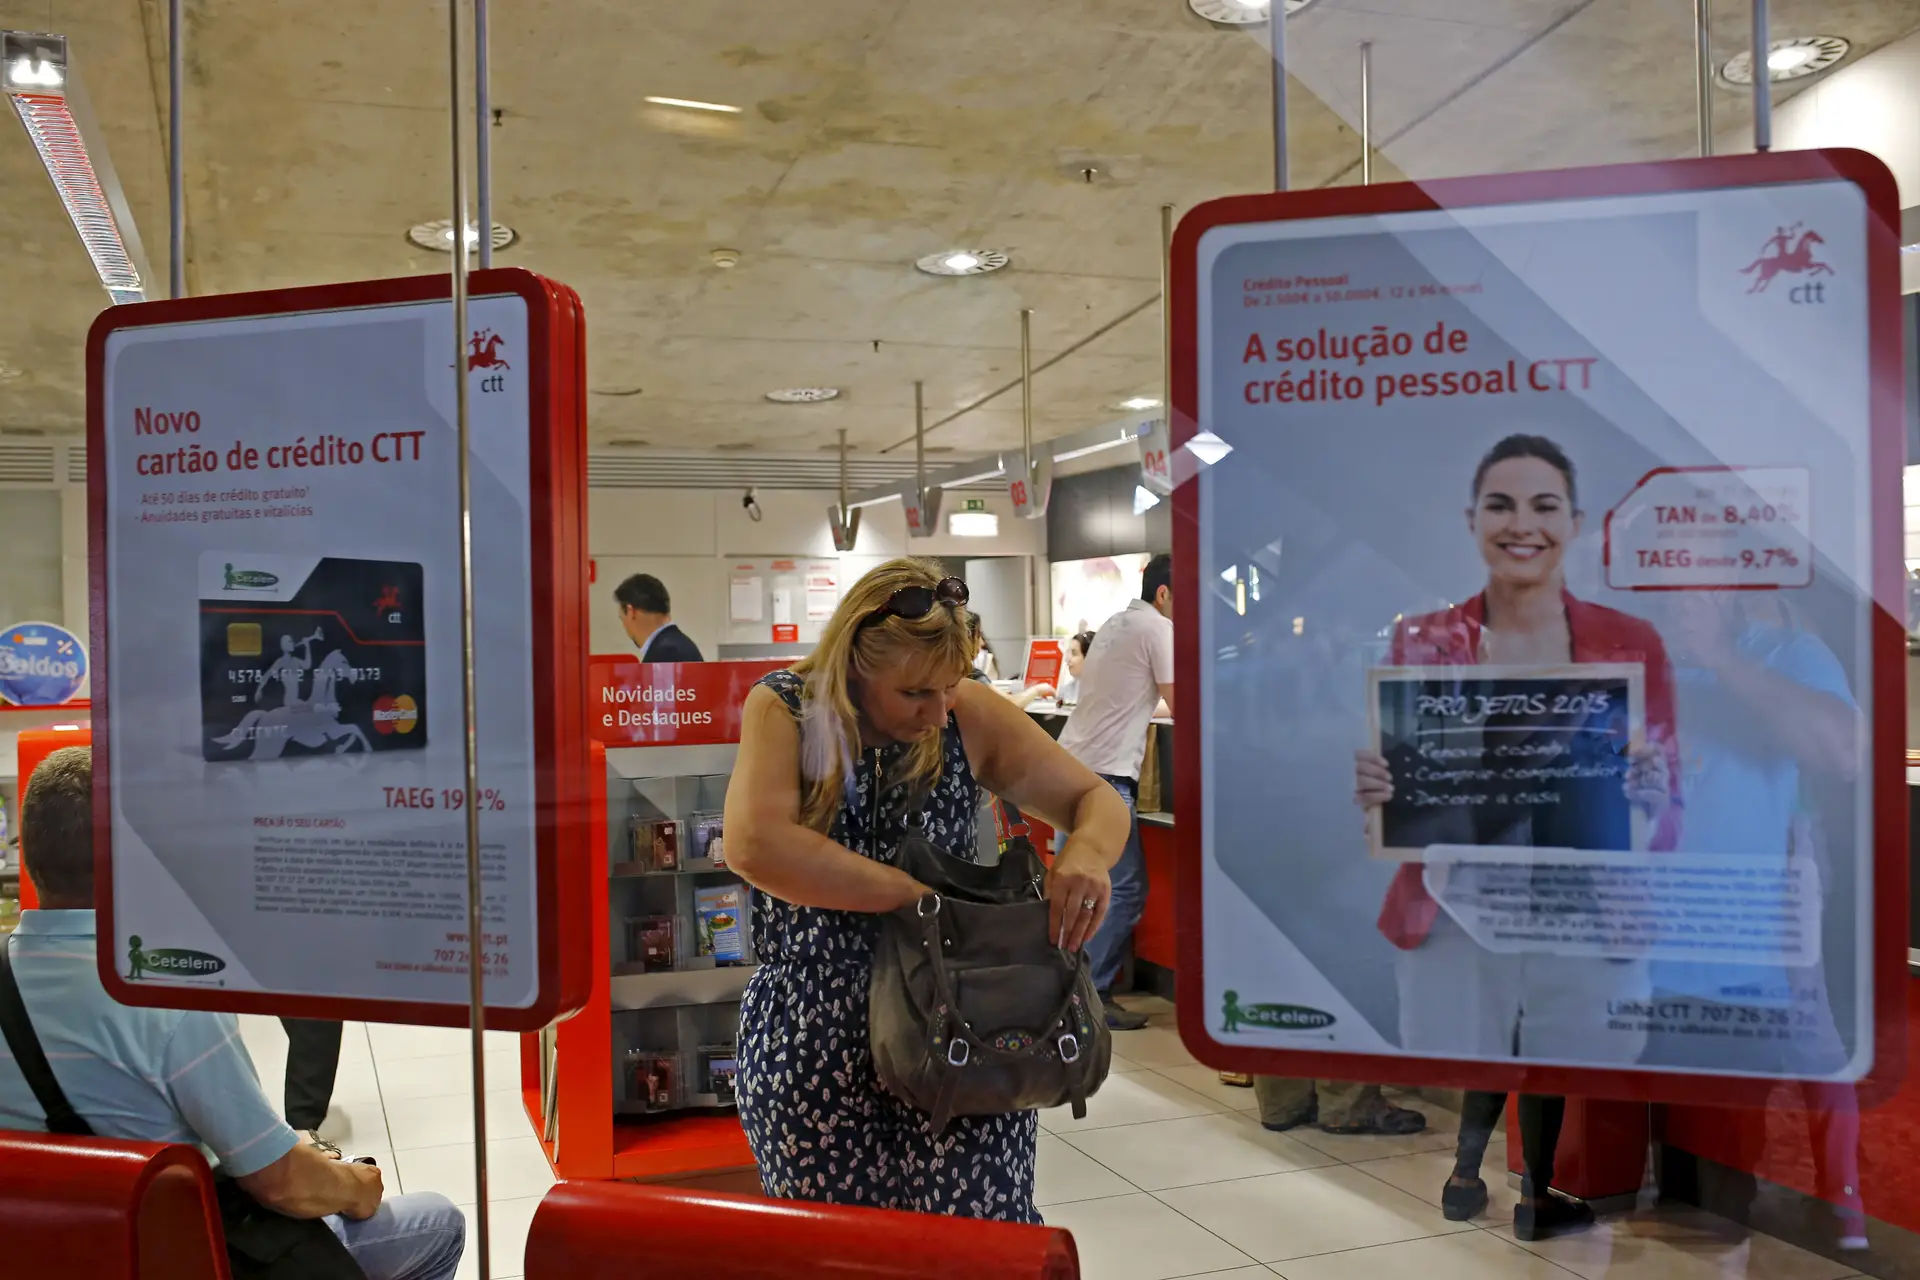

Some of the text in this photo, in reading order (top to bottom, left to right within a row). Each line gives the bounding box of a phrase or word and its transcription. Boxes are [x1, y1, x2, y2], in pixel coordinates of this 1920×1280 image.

[1789, 281, 1825, 304] ctt
[1243, 321, 1469, 366] A solução de
[481, 375, 505, 393] ctt
[1244, 357, 1599, 407] crédito pessoal CTT
[135, 407, 201, 436] Novo
[136, 430, 426, 476] cartão de crédito CTT
[1144, 449, 1169, 477] 04
[141, 491, 160, 506] Até
[178, 489, 200, 504] dias
[203, 487, 217, 503] de
[219, 486, 260, 502] crédito
[1010, 480, 1028, 507] 03
[141, 509, 199, 523] Anuidades
[201, 507, 252, 523] gratuitas
[254, 509, 261, 519] e
[1654, 505, 1696, 524] TAN
[1637, 549, 1692, 568] TAEG
[602, 684, 697, 704] Novidades
[1552, 692, 1612, 715] 2015
[602, 709, 712, 729] e Destaques
[382, 786, 435, 809] TAEG
[148, 953, 219, 970] Cetelem
[433, 948, 456, 962] 707
[1244, 1006, 1329, 1025] Cetelem
[1606, 1001, 1655, 1018] Linha
[1658, 1003, 1691, 1020] CTT
[1700, 1004, 1733, 1022] 707
